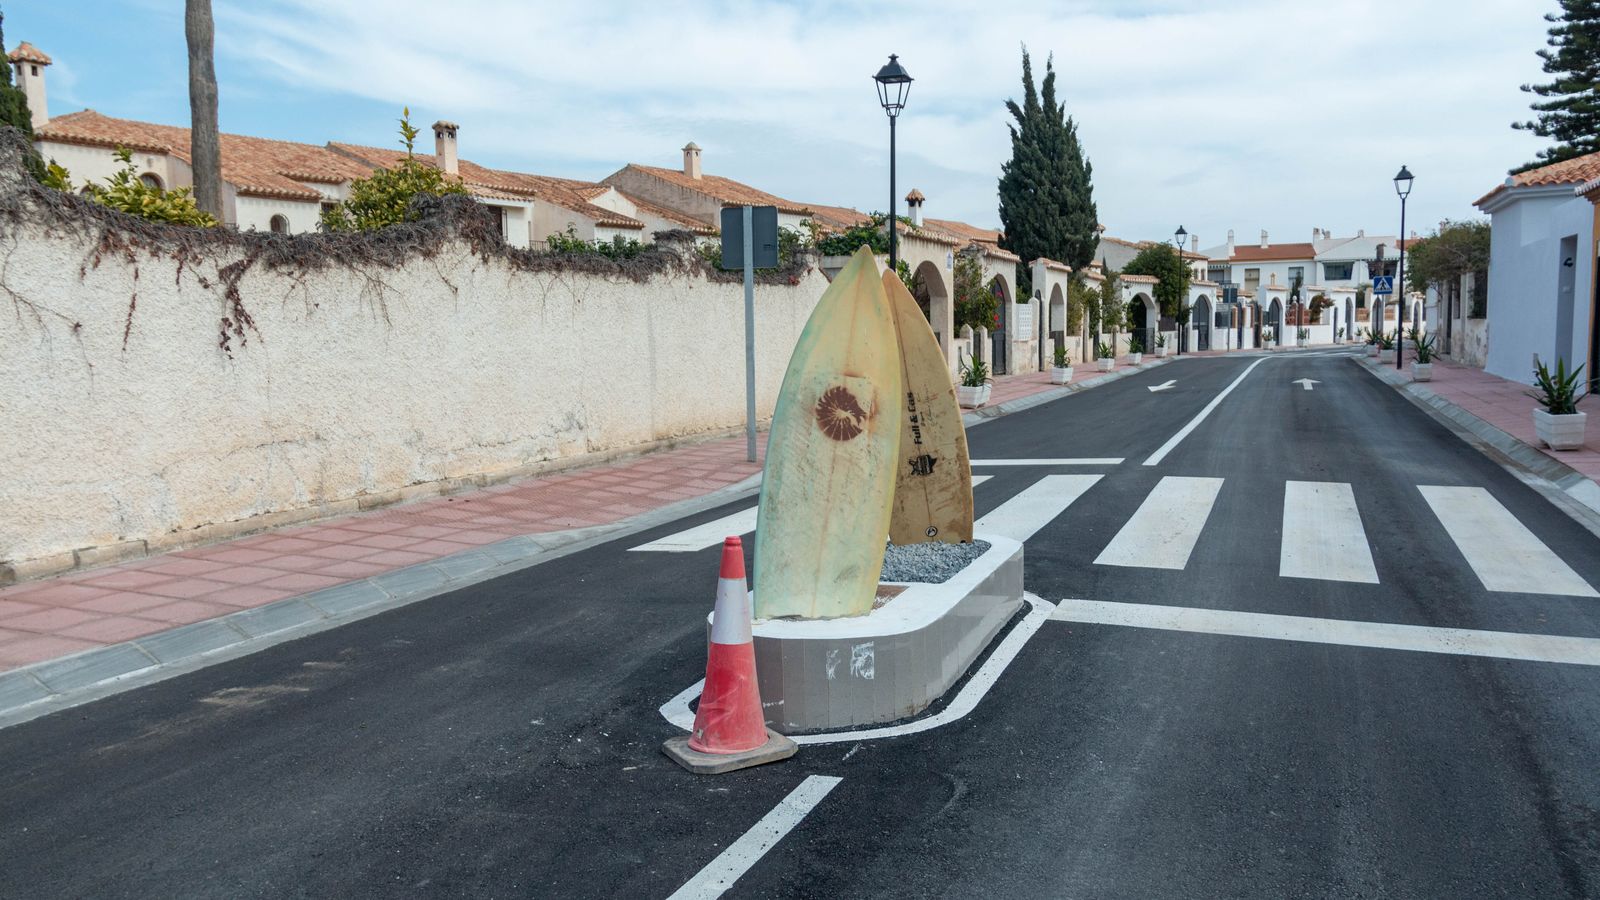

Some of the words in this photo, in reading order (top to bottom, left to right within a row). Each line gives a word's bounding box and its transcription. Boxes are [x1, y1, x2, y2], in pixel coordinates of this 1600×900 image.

[907, 391, 916, 412] Cas
[910, 414, 918, 423] &
[912, 425, 922, 445] Full
